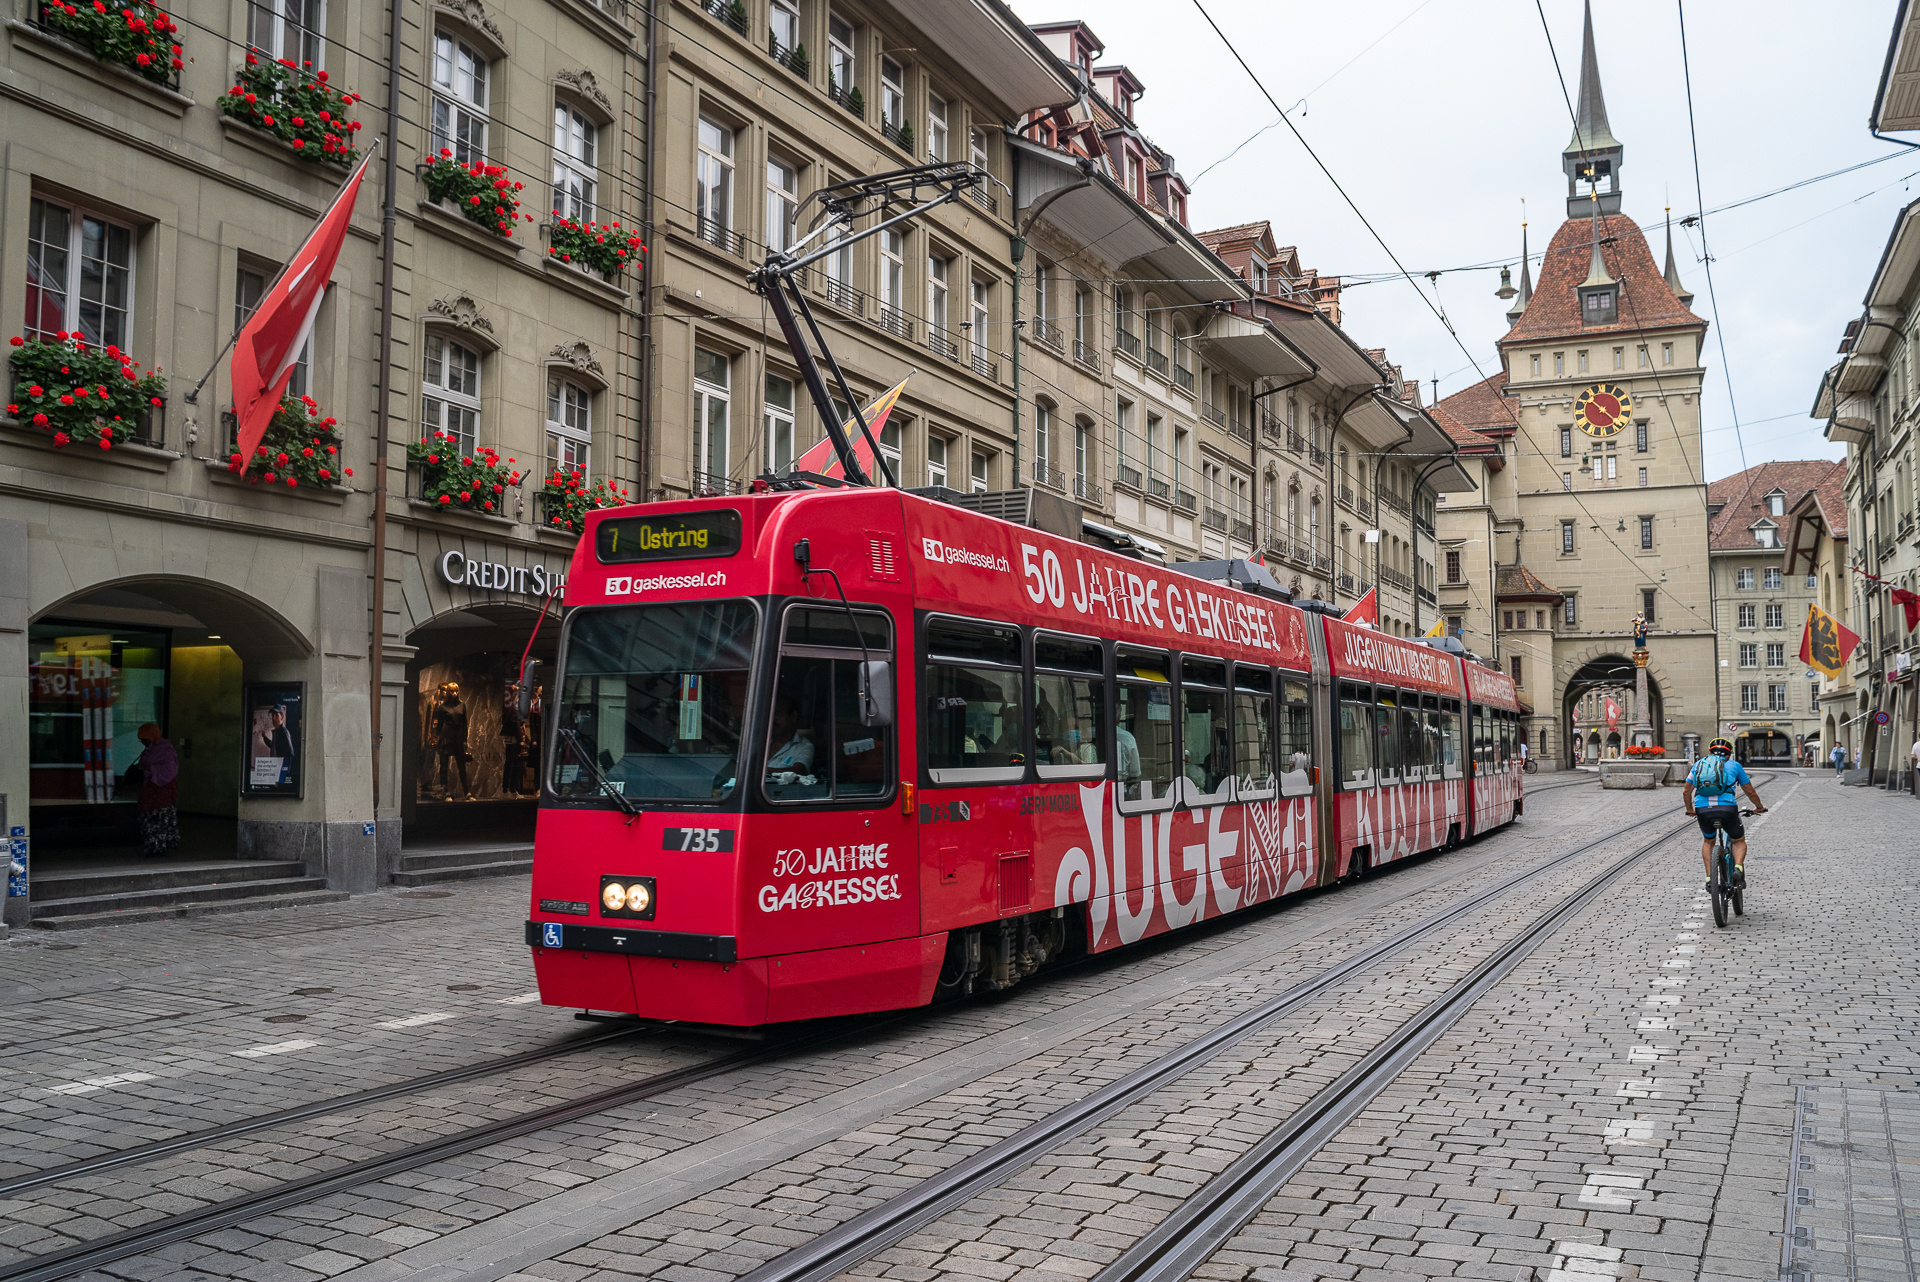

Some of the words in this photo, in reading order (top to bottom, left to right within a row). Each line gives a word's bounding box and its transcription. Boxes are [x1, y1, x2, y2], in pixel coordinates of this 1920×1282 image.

[609, 528, 618, 552] 7
[640, 524, 708, 550] Ostring
[442, 550, 529, 594] CREDIT
[945, 546, 1010, 573] gaskessel.ch
[633, 571, 727, 594] gaskessel.ch
[1021, 542, 1065, 609] 50
[1069, 558, 1164, 630] JAHRE
[1166, 583, 1281, 651] GASKESSEL
[1345, 631, 1422, 679] JUGENDKULTUR
[680, 828, 720, 852] 735
[773, 849, 806, 877] 50
[808, 843, 889, 874] JAHRE
[1055, 769, 1313, 948] JUGEND
[758, 874, 902, 913] GASKESSEL
